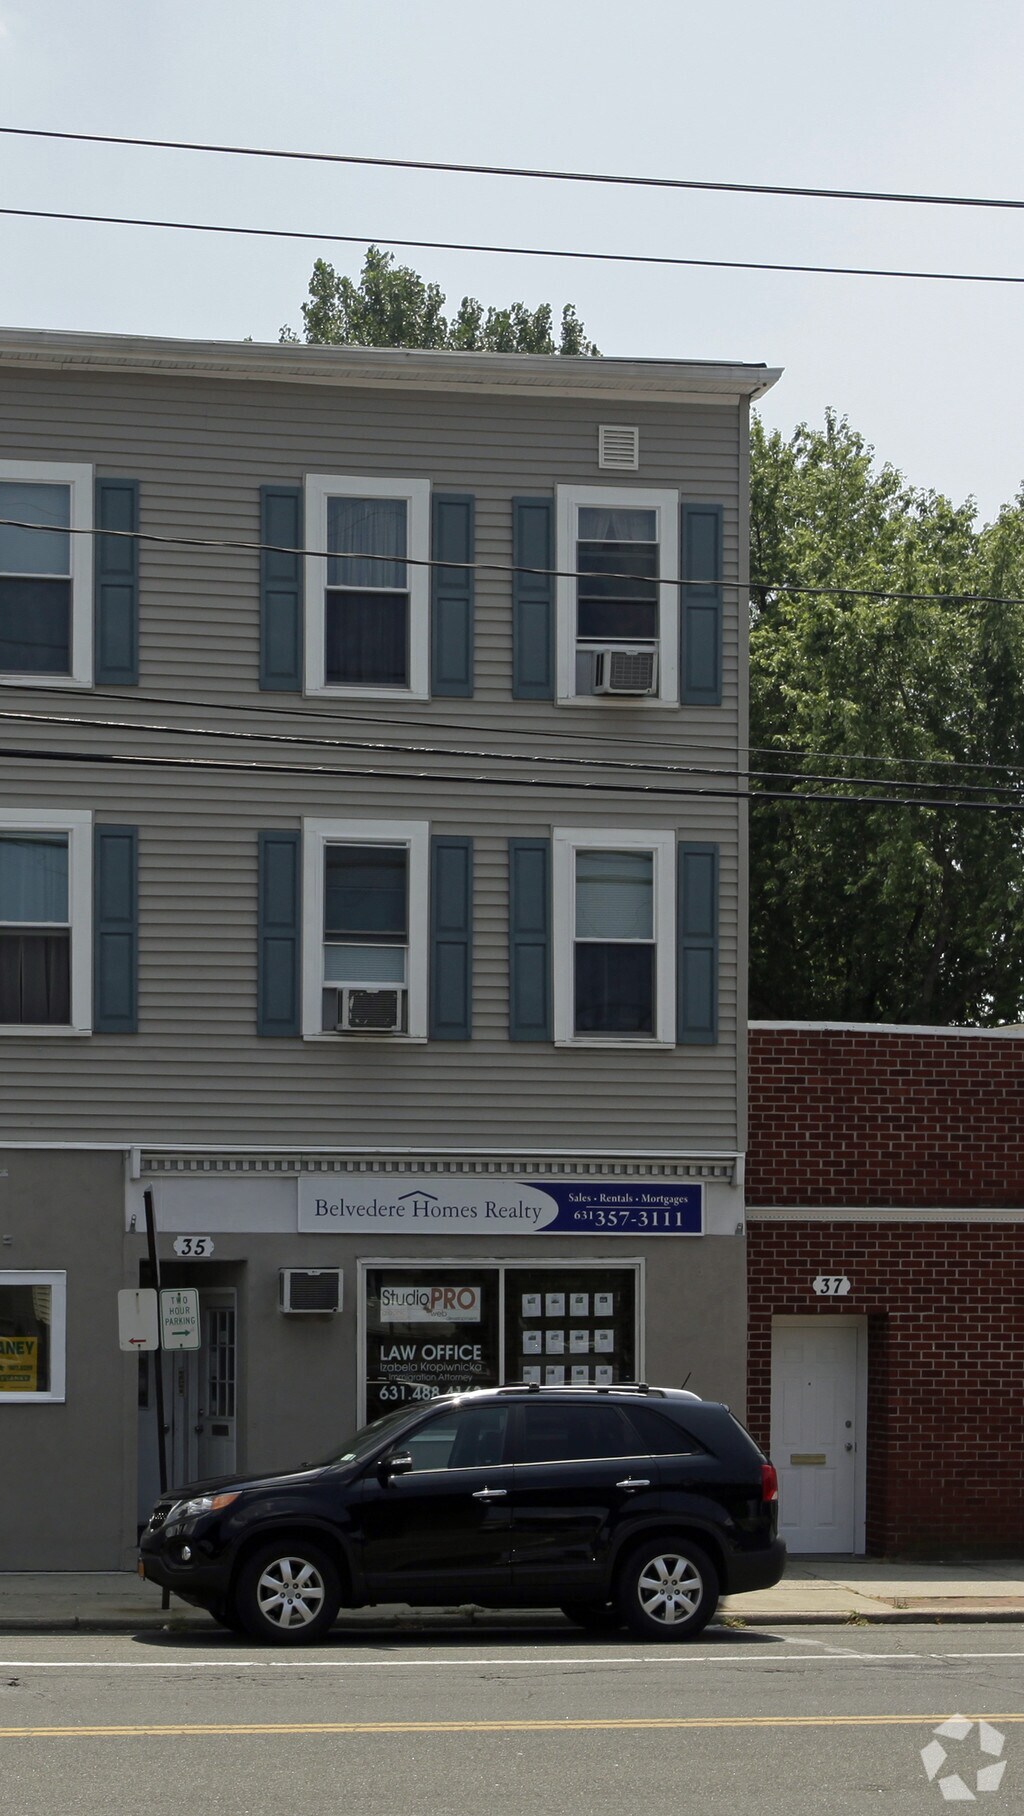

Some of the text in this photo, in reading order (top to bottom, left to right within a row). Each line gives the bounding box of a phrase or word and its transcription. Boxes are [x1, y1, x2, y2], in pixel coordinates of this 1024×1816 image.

[568, 1192, 688, 1206] Sales Rentals Mortgages
[315, 1198, 542, 1224] Belvedere Homes Realty
[181, 1238, 206, 1256] 35
[820, 1277, 843, 1294] 37
[169, 1307, 190, 1316] HOUR
[164, 1316, 196, 1326] PARKING
[380, 1344, 481, 1360] LAW OFFICE
[380, 1362, 482, 1373] Izabela Kropiwnicka
[388, 1373, 473, 1382] Immigration Attorney
